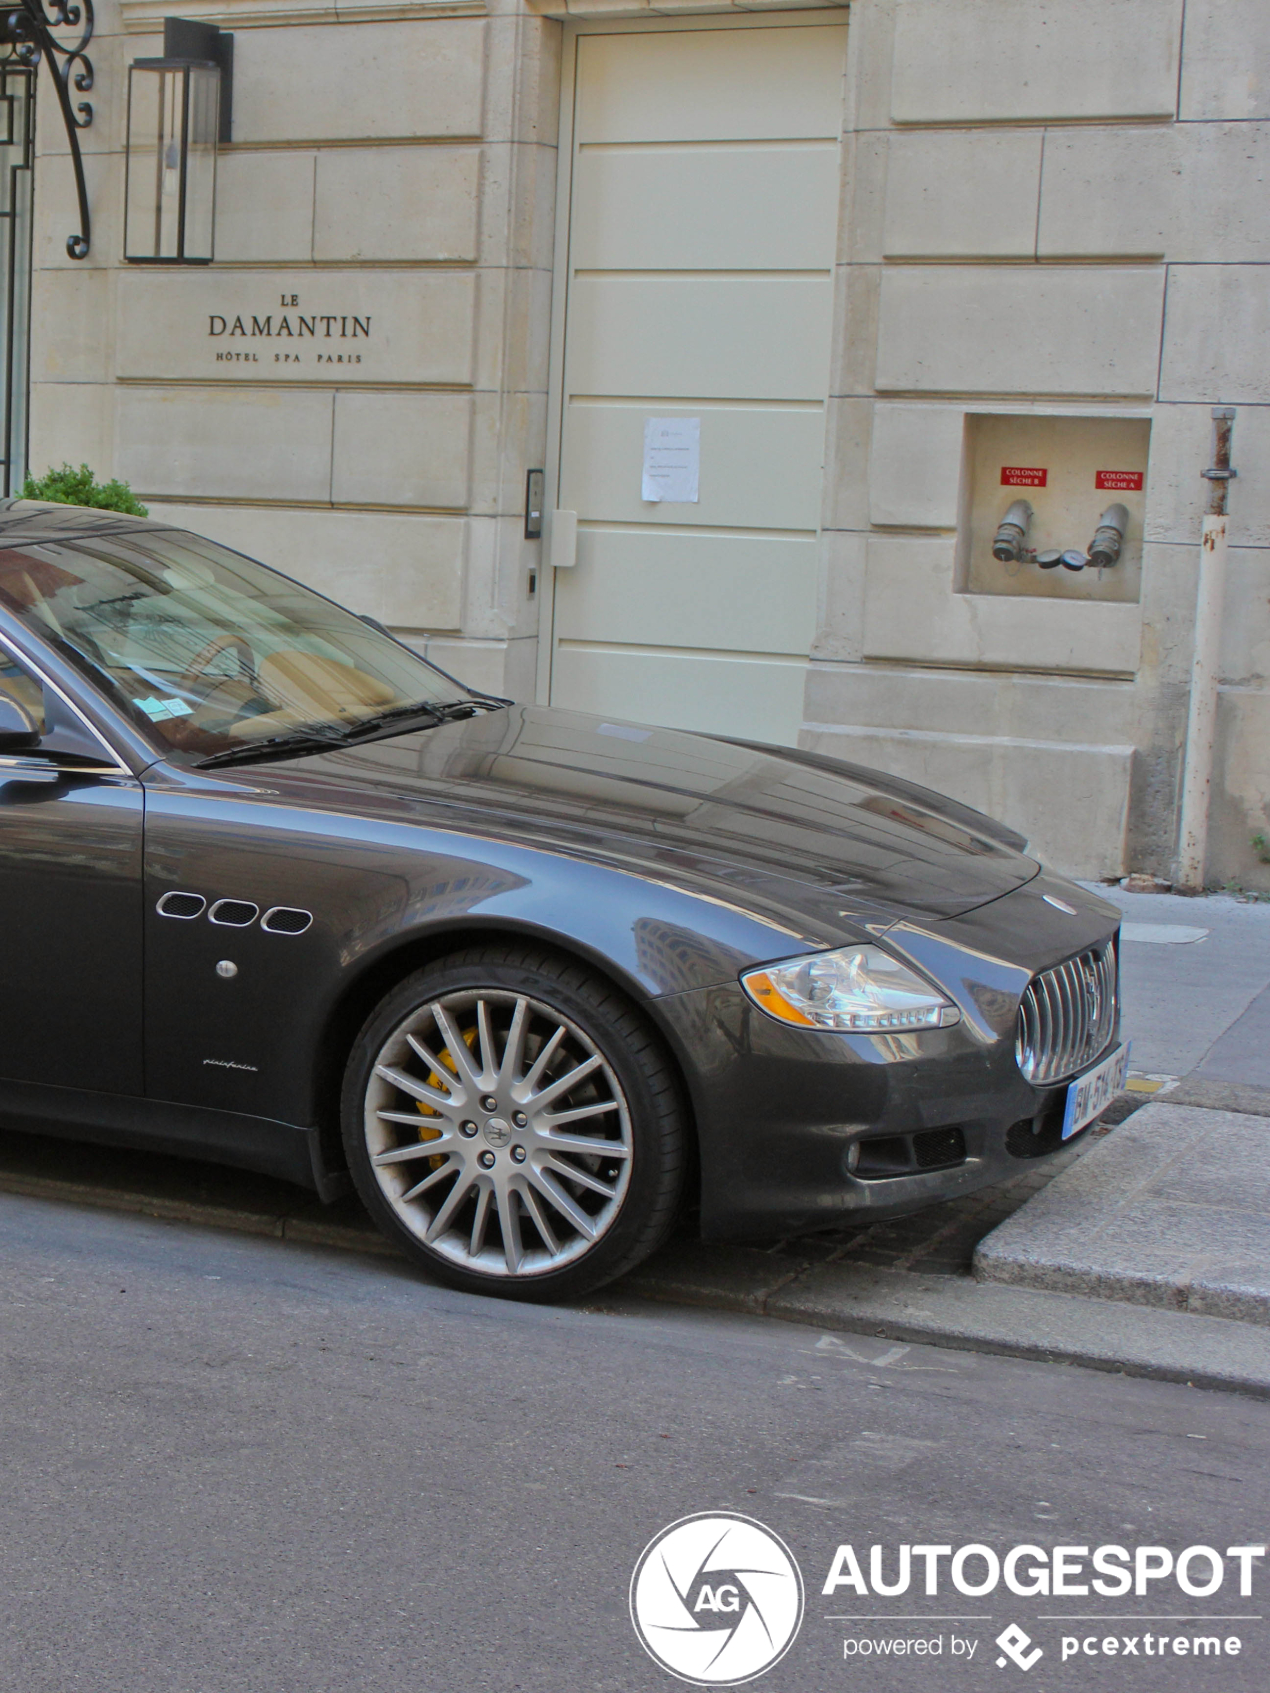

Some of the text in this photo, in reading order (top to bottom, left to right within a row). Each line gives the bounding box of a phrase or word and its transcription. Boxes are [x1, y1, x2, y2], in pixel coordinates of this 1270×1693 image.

[280, 294, 299, 307] LE
[208, 315, 372, 338] DAMANTIN
[216, 351, 362, 364] HÔTEL SPA PARIS
[1006, 469, 1043, 477] COLONNE
[1101, 472, 1139, 480] COLONNE
